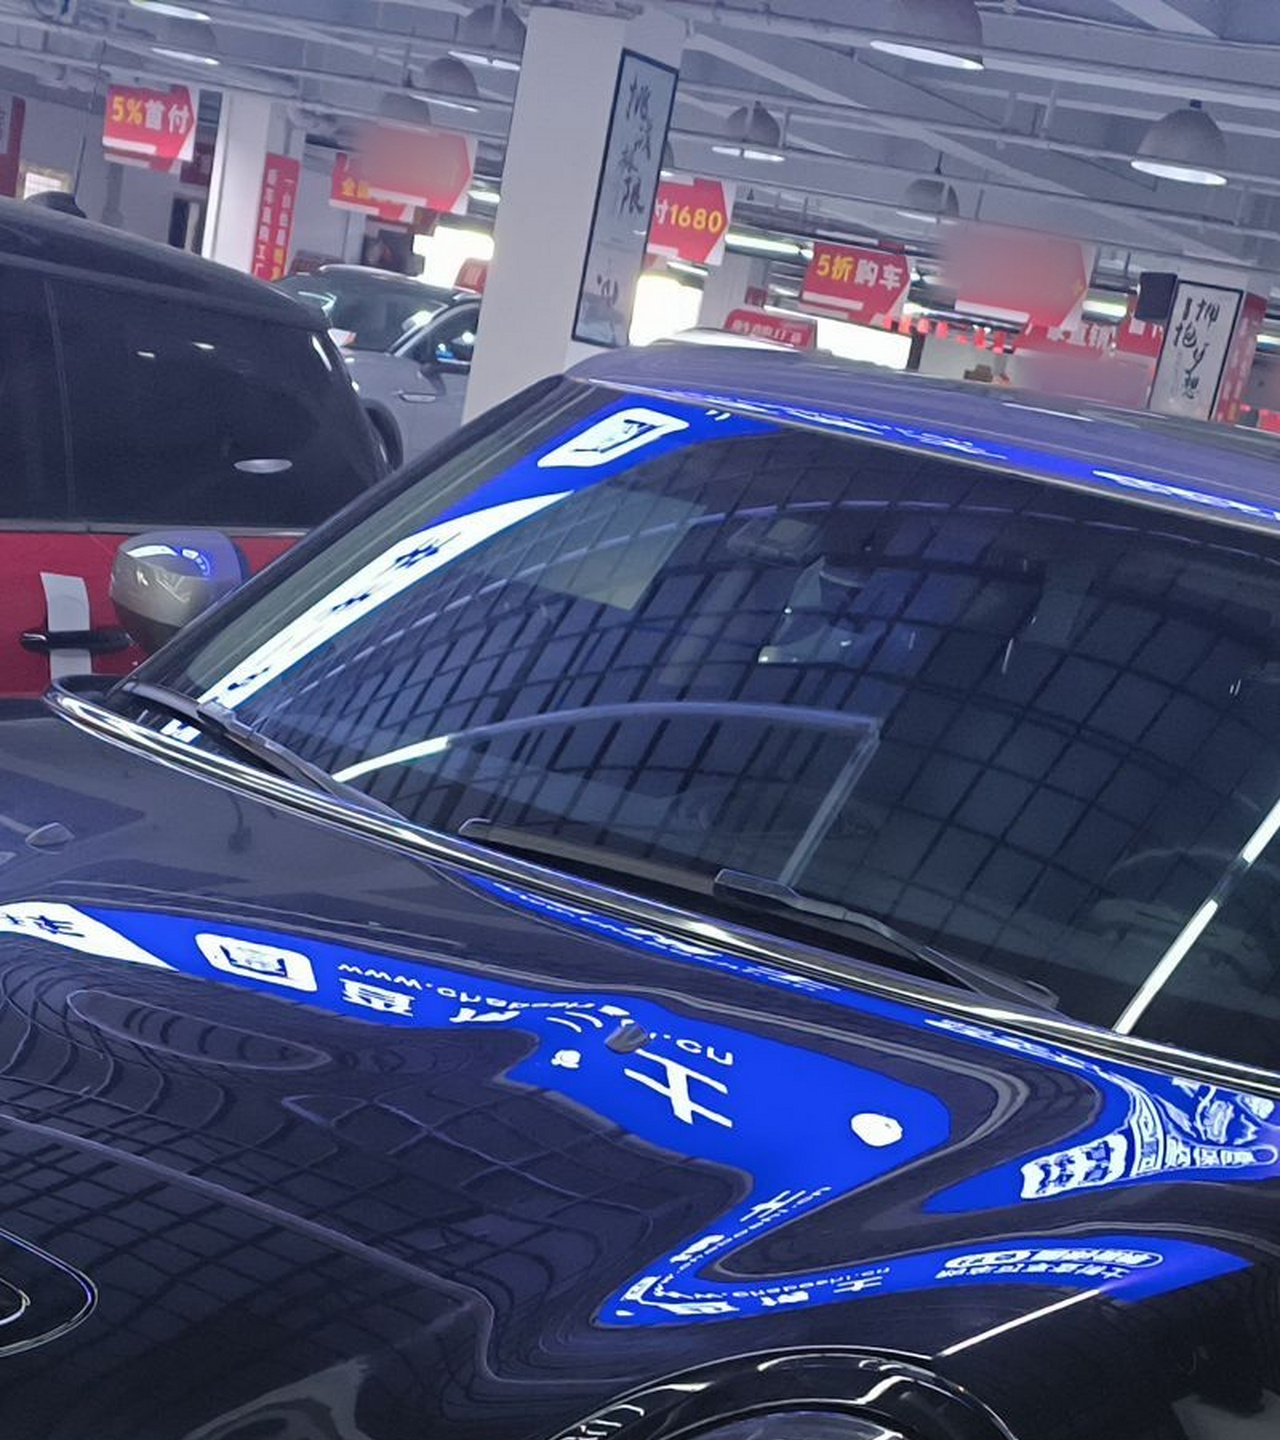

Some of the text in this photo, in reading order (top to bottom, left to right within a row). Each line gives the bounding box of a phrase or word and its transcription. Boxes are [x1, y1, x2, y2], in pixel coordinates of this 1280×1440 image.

[112, 95, 190, 135] 5%首付
[816, 254, 904, 291] 5折购车
